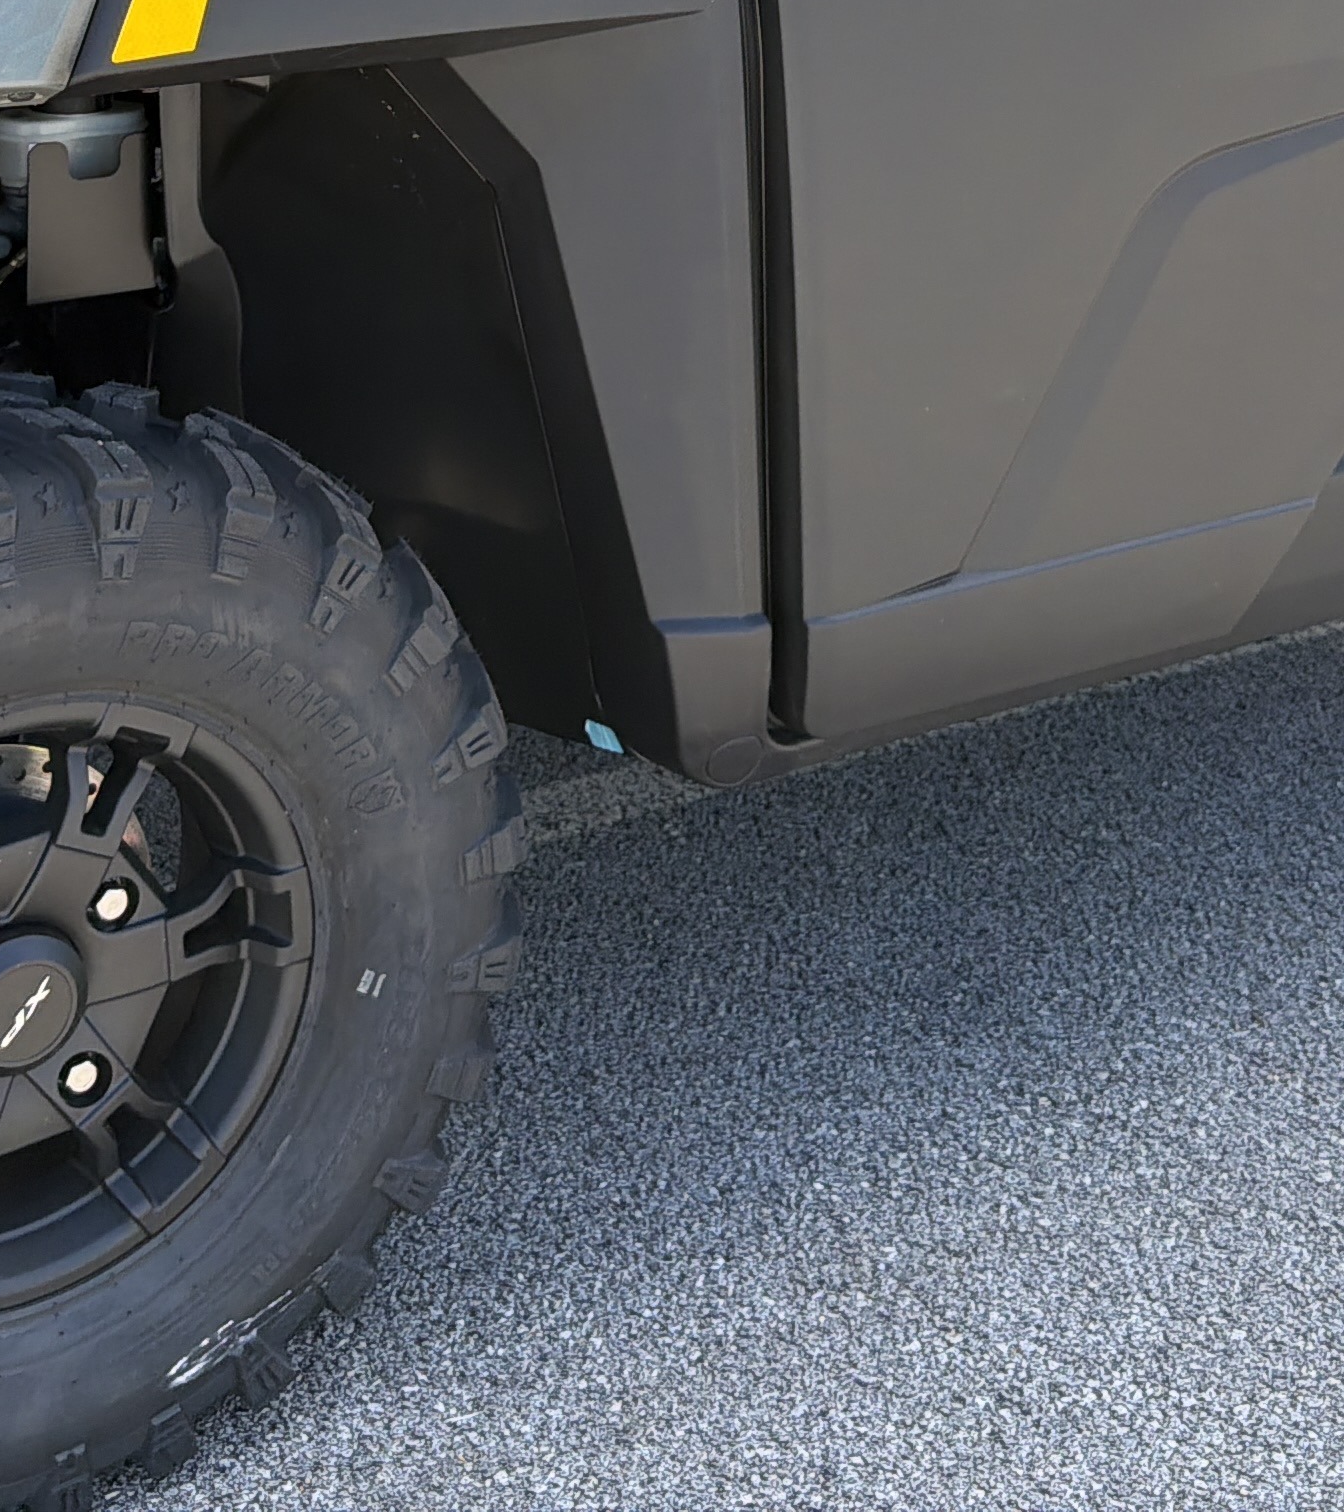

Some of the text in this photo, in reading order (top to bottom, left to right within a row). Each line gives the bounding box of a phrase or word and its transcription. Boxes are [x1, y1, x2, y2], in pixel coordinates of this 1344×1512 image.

[118, 620, 378, 771] PRO ARMOR
[0, 974, 52, 1050] XP
